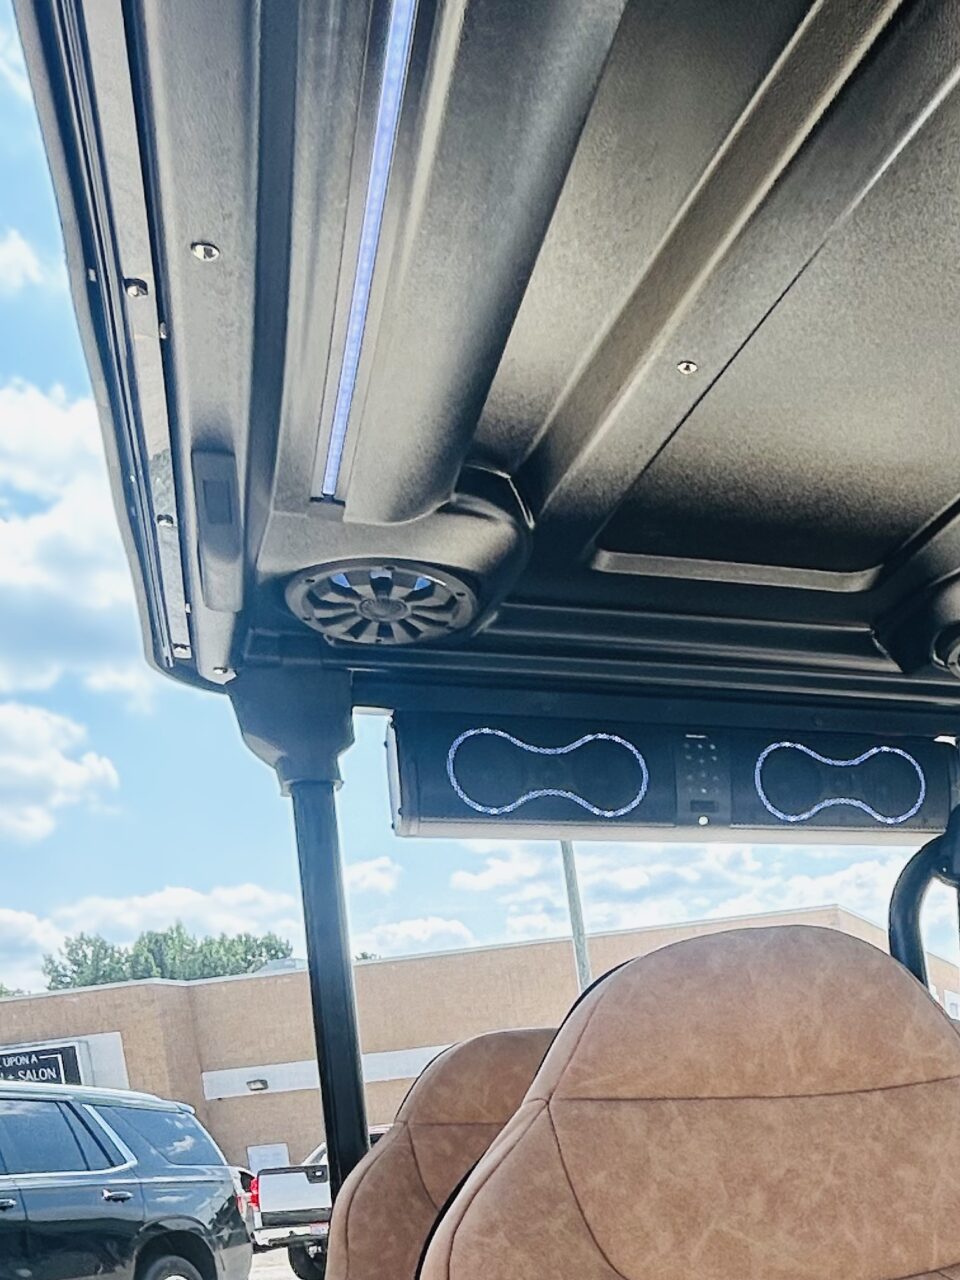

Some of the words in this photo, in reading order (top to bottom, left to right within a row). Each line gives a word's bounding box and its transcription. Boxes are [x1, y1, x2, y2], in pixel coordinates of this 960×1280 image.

[2, 1054, 30, 1067] UPON
[30, 1053, 39, 1064] A
[17, 1067, 57, 1081] SALON
